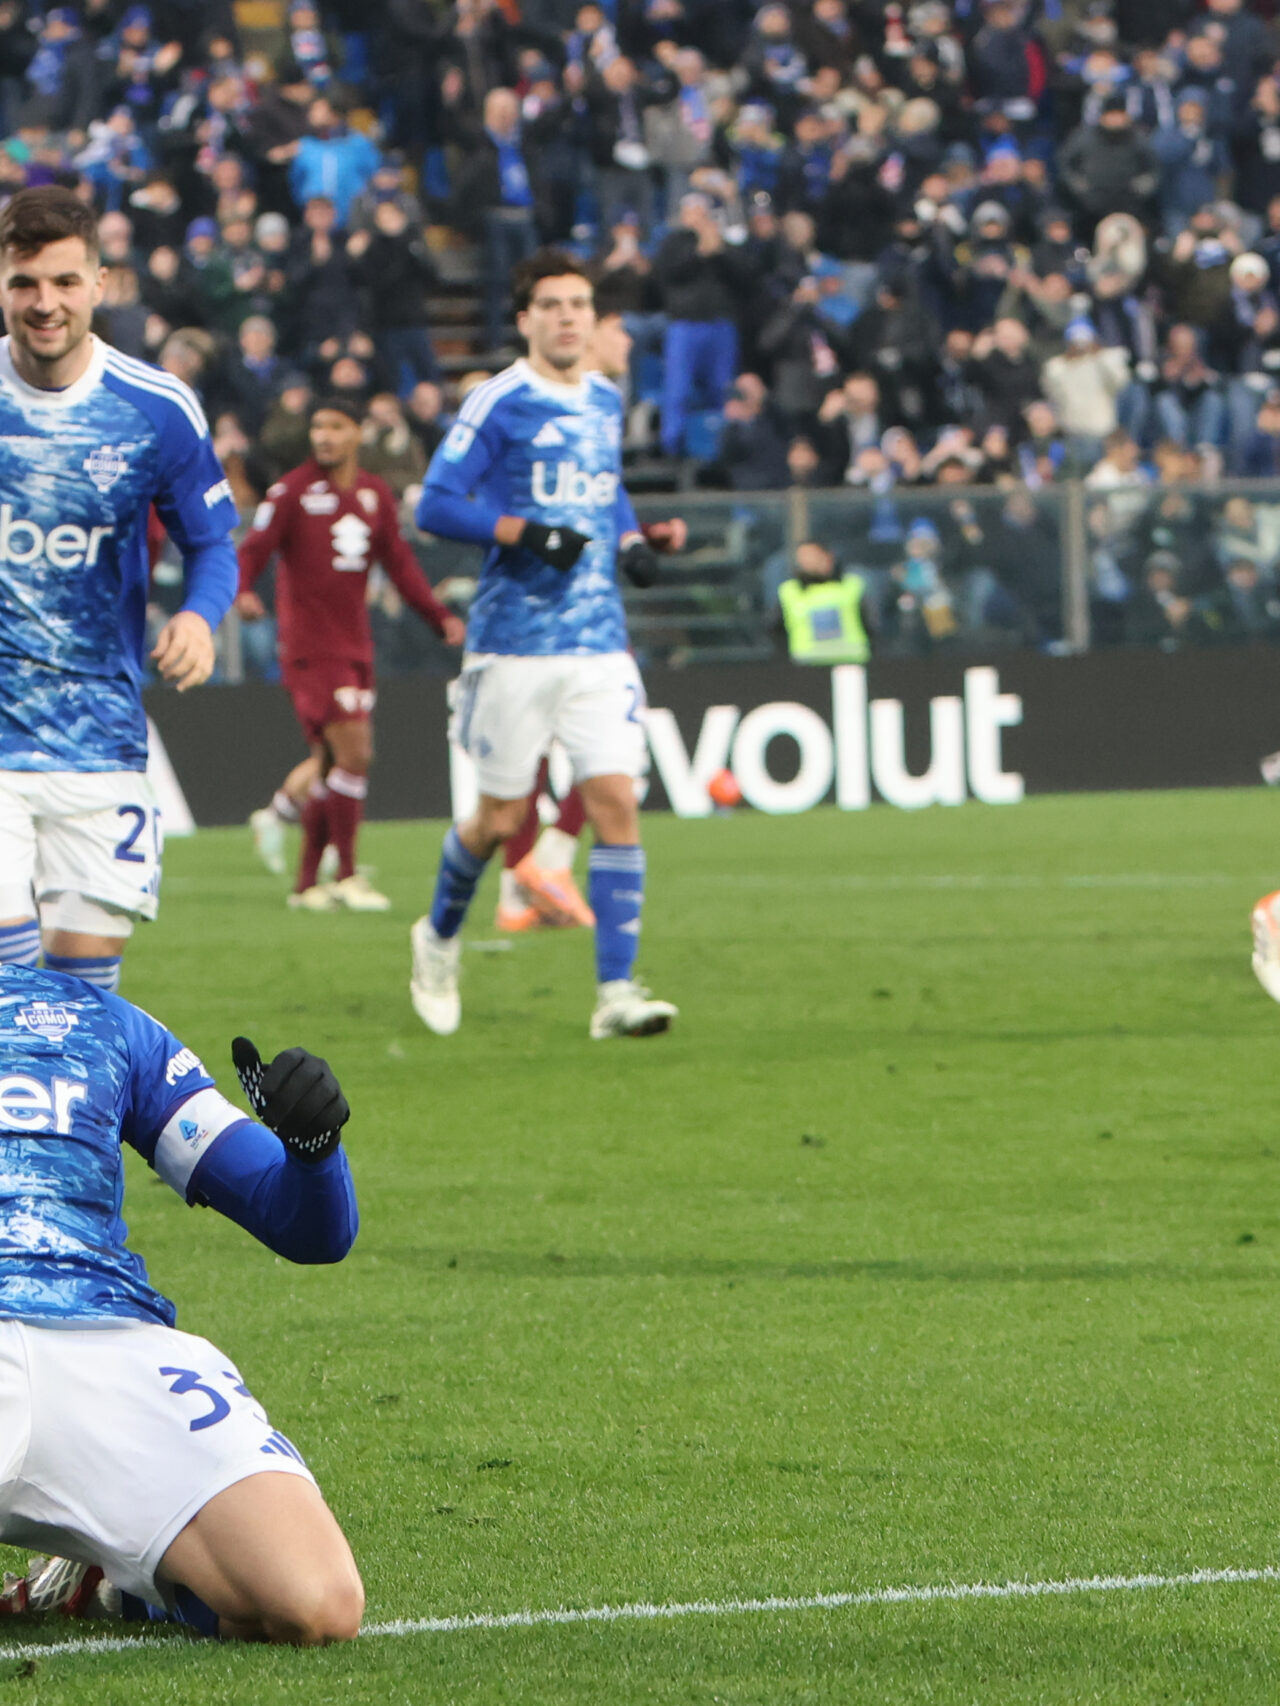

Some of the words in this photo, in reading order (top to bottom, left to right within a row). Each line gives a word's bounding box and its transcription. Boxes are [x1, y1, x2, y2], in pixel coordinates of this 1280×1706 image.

[447, 665, 1024, 823] volut
[114, 803, 161, 865] 2
[27, 1013, 67, 1025] COMO
